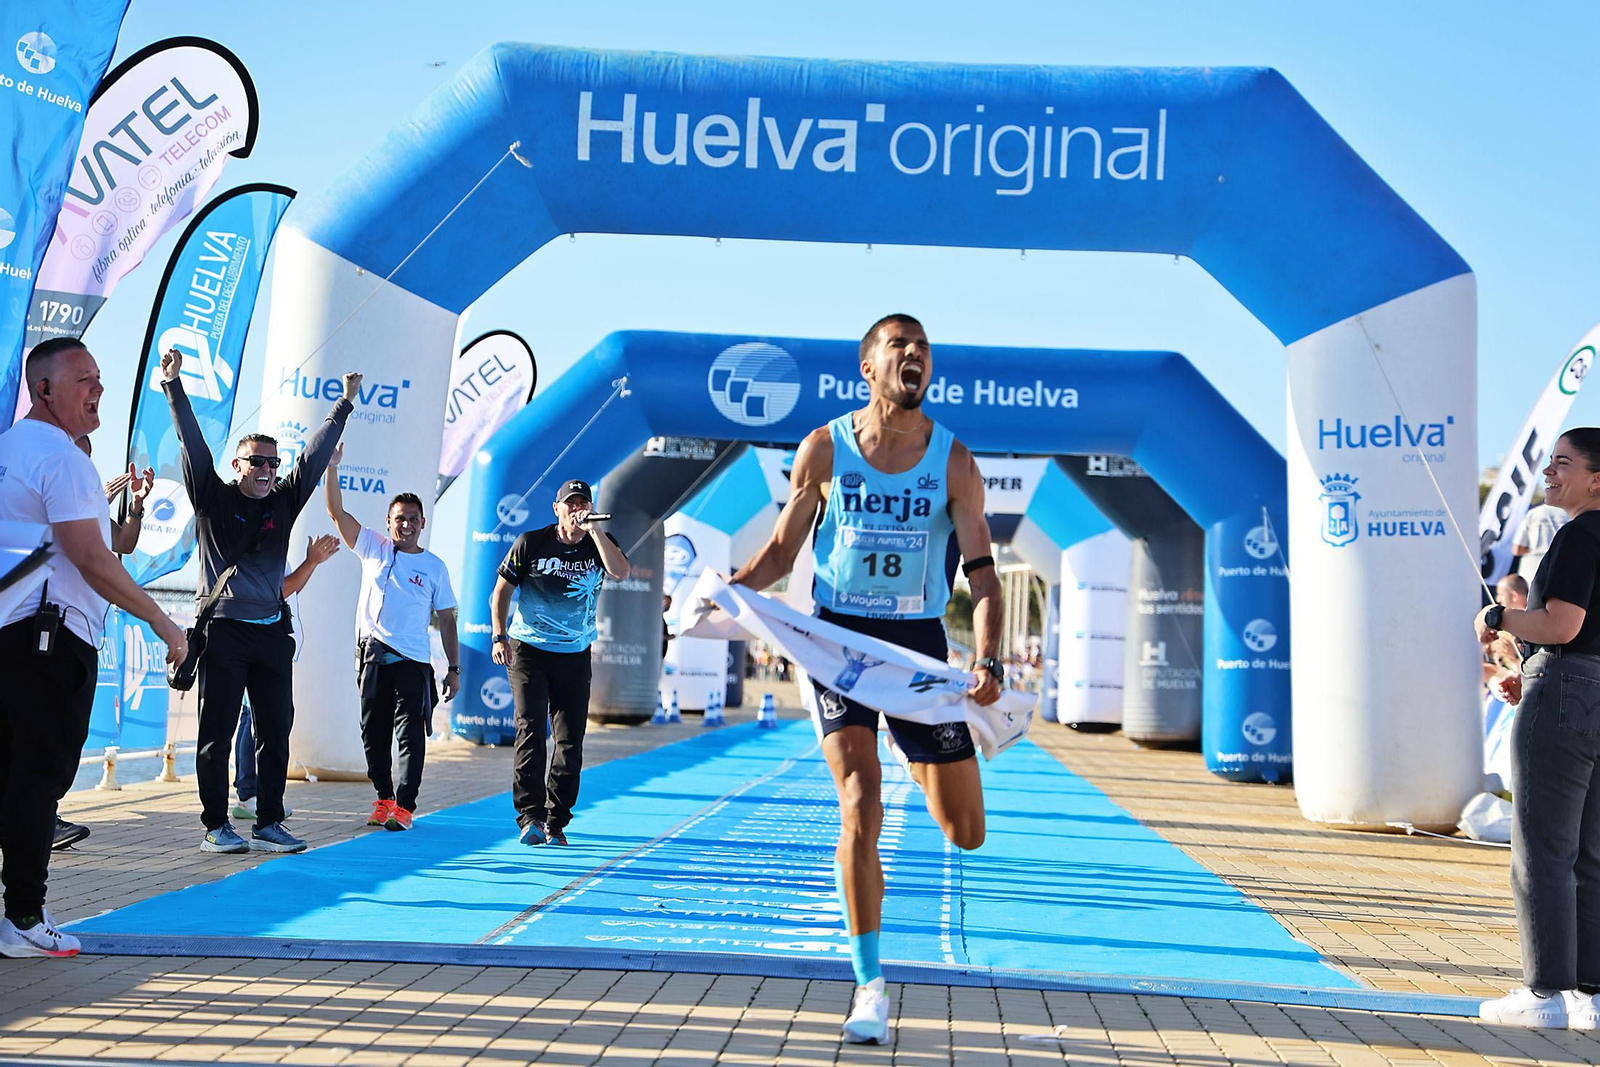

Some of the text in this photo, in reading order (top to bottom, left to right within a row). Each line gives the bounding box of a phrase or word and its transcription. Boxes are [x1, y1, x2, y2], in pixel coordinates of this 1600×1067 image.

[17, 80, 34, 96] de
[37, 86, 82, 114] Huelva
[158, 105, 232, 167] TELECOM
[576, 90, 1169, 197] Huelva original
[91, 250, 119, 284] fibra
[118, 218, 147, 252] óptica
[150, 170, 195, 216] telefonía
[179, 230, 237, 337] HUELVA
[210, 236, 248, 341] PUERTA DEL DESCUBRIMIENTO
[39, 299, 85, 326] 1790
[278, 366, 399, 409] Hueva
[818, 373, 1080, 409] Pue de Huelva
[351, 410, 396, 425] original
[1318, 415, 1446, 450] Huelva
[843, 488, 931, 523] nerja
[1368, 510, 1434, 519] Ayuntamiento
[473, 530, 500, 543] Puerto
[1368, 521, 1446, 537] HUELVA
[560, 557, 597, 573] HUELVA
[862, 552, 902, 578] 18
[1219, 566, 1251, 577] Puerto
[1252, 566, 1267, 576] de
[850, 594, 892, 607] Wayalia
[1217, 659, 1250, 670] Puerto
[1252, 659, 1267, 669] de
[456, 713, 485, 726] Puerto
[486, 714, 500, 727] de
[1217, 752, 1249, 763] Puerto
[1251, 752, 1266, 762] de
